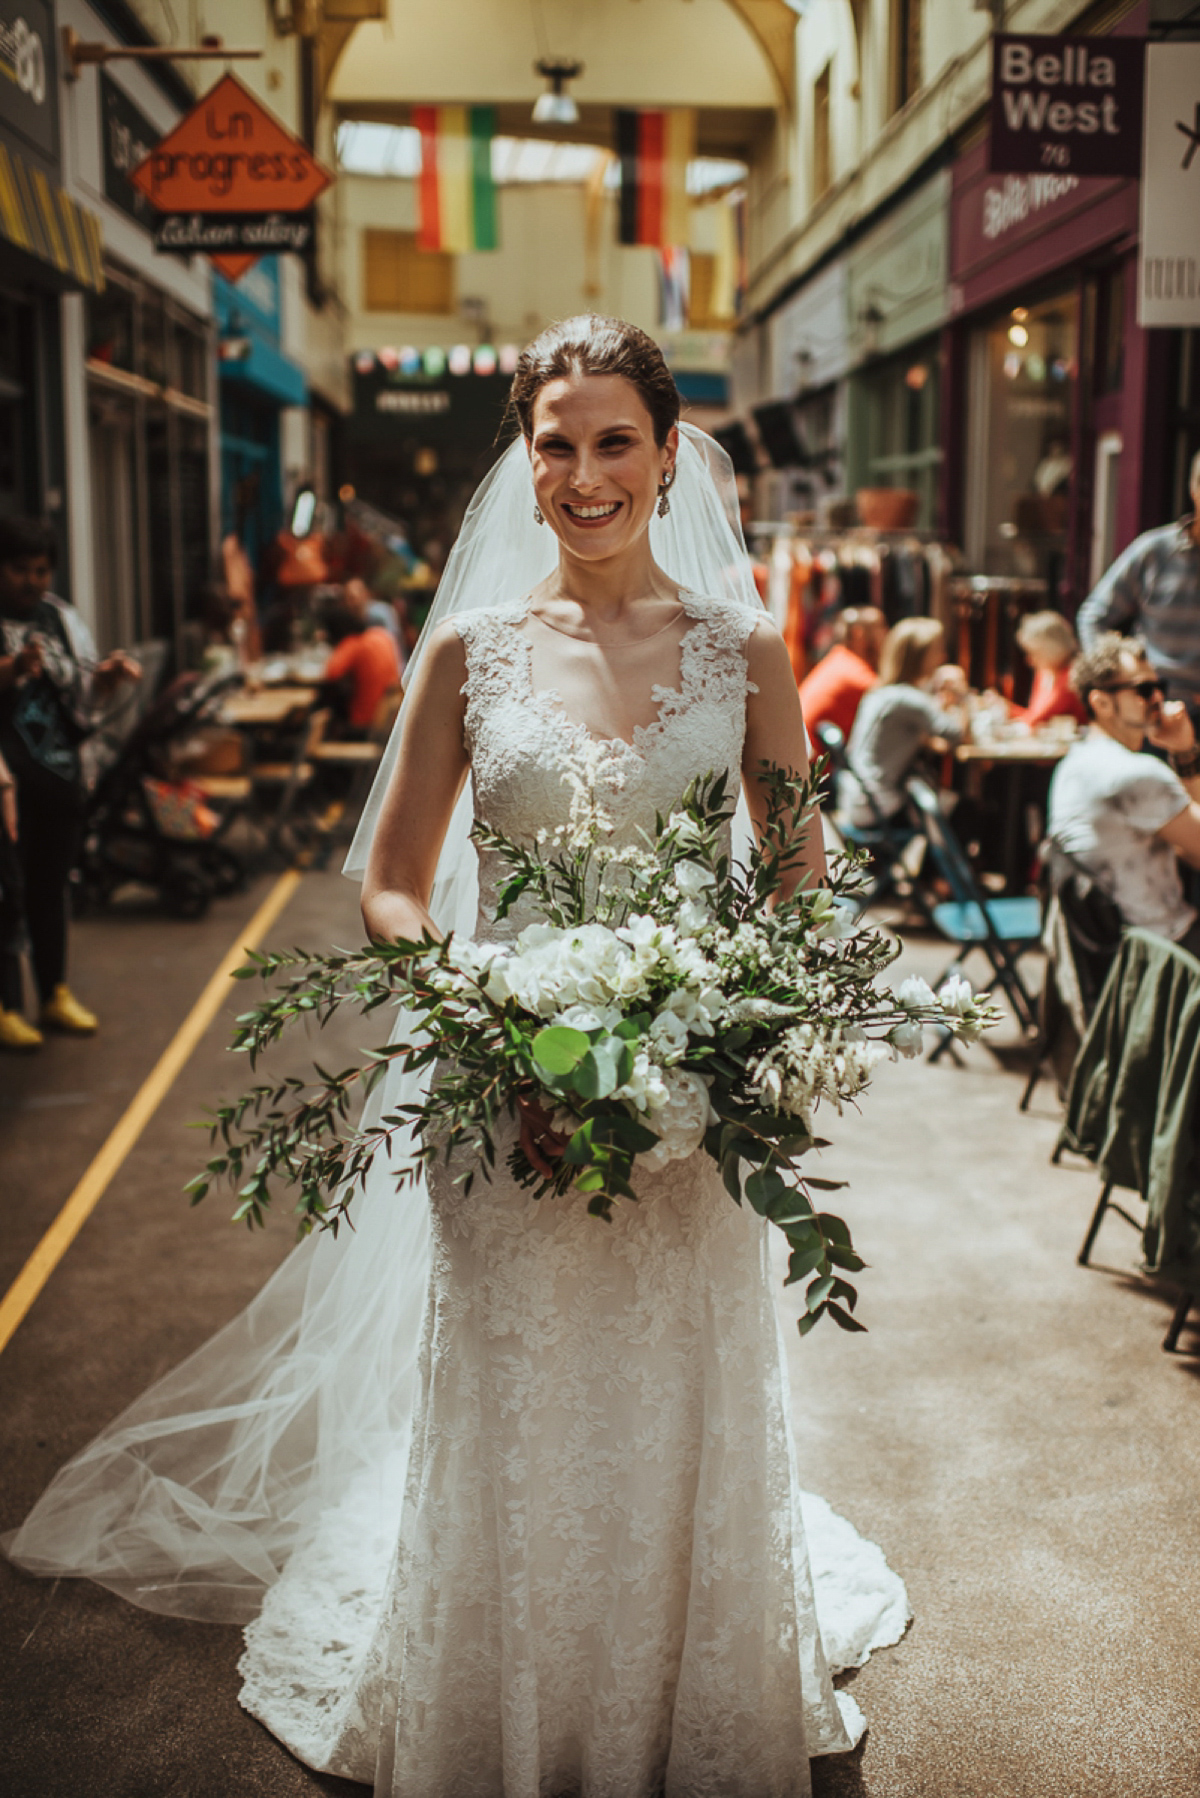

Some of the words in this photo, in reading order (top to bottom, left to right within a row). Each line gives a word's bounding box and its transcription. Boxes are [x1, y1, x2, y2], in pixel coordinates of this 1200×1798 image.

[1001, 43, 1116, 86] Bella
[1001, 90, 1119, 133] West
[151, 152, 309, 195] progress
